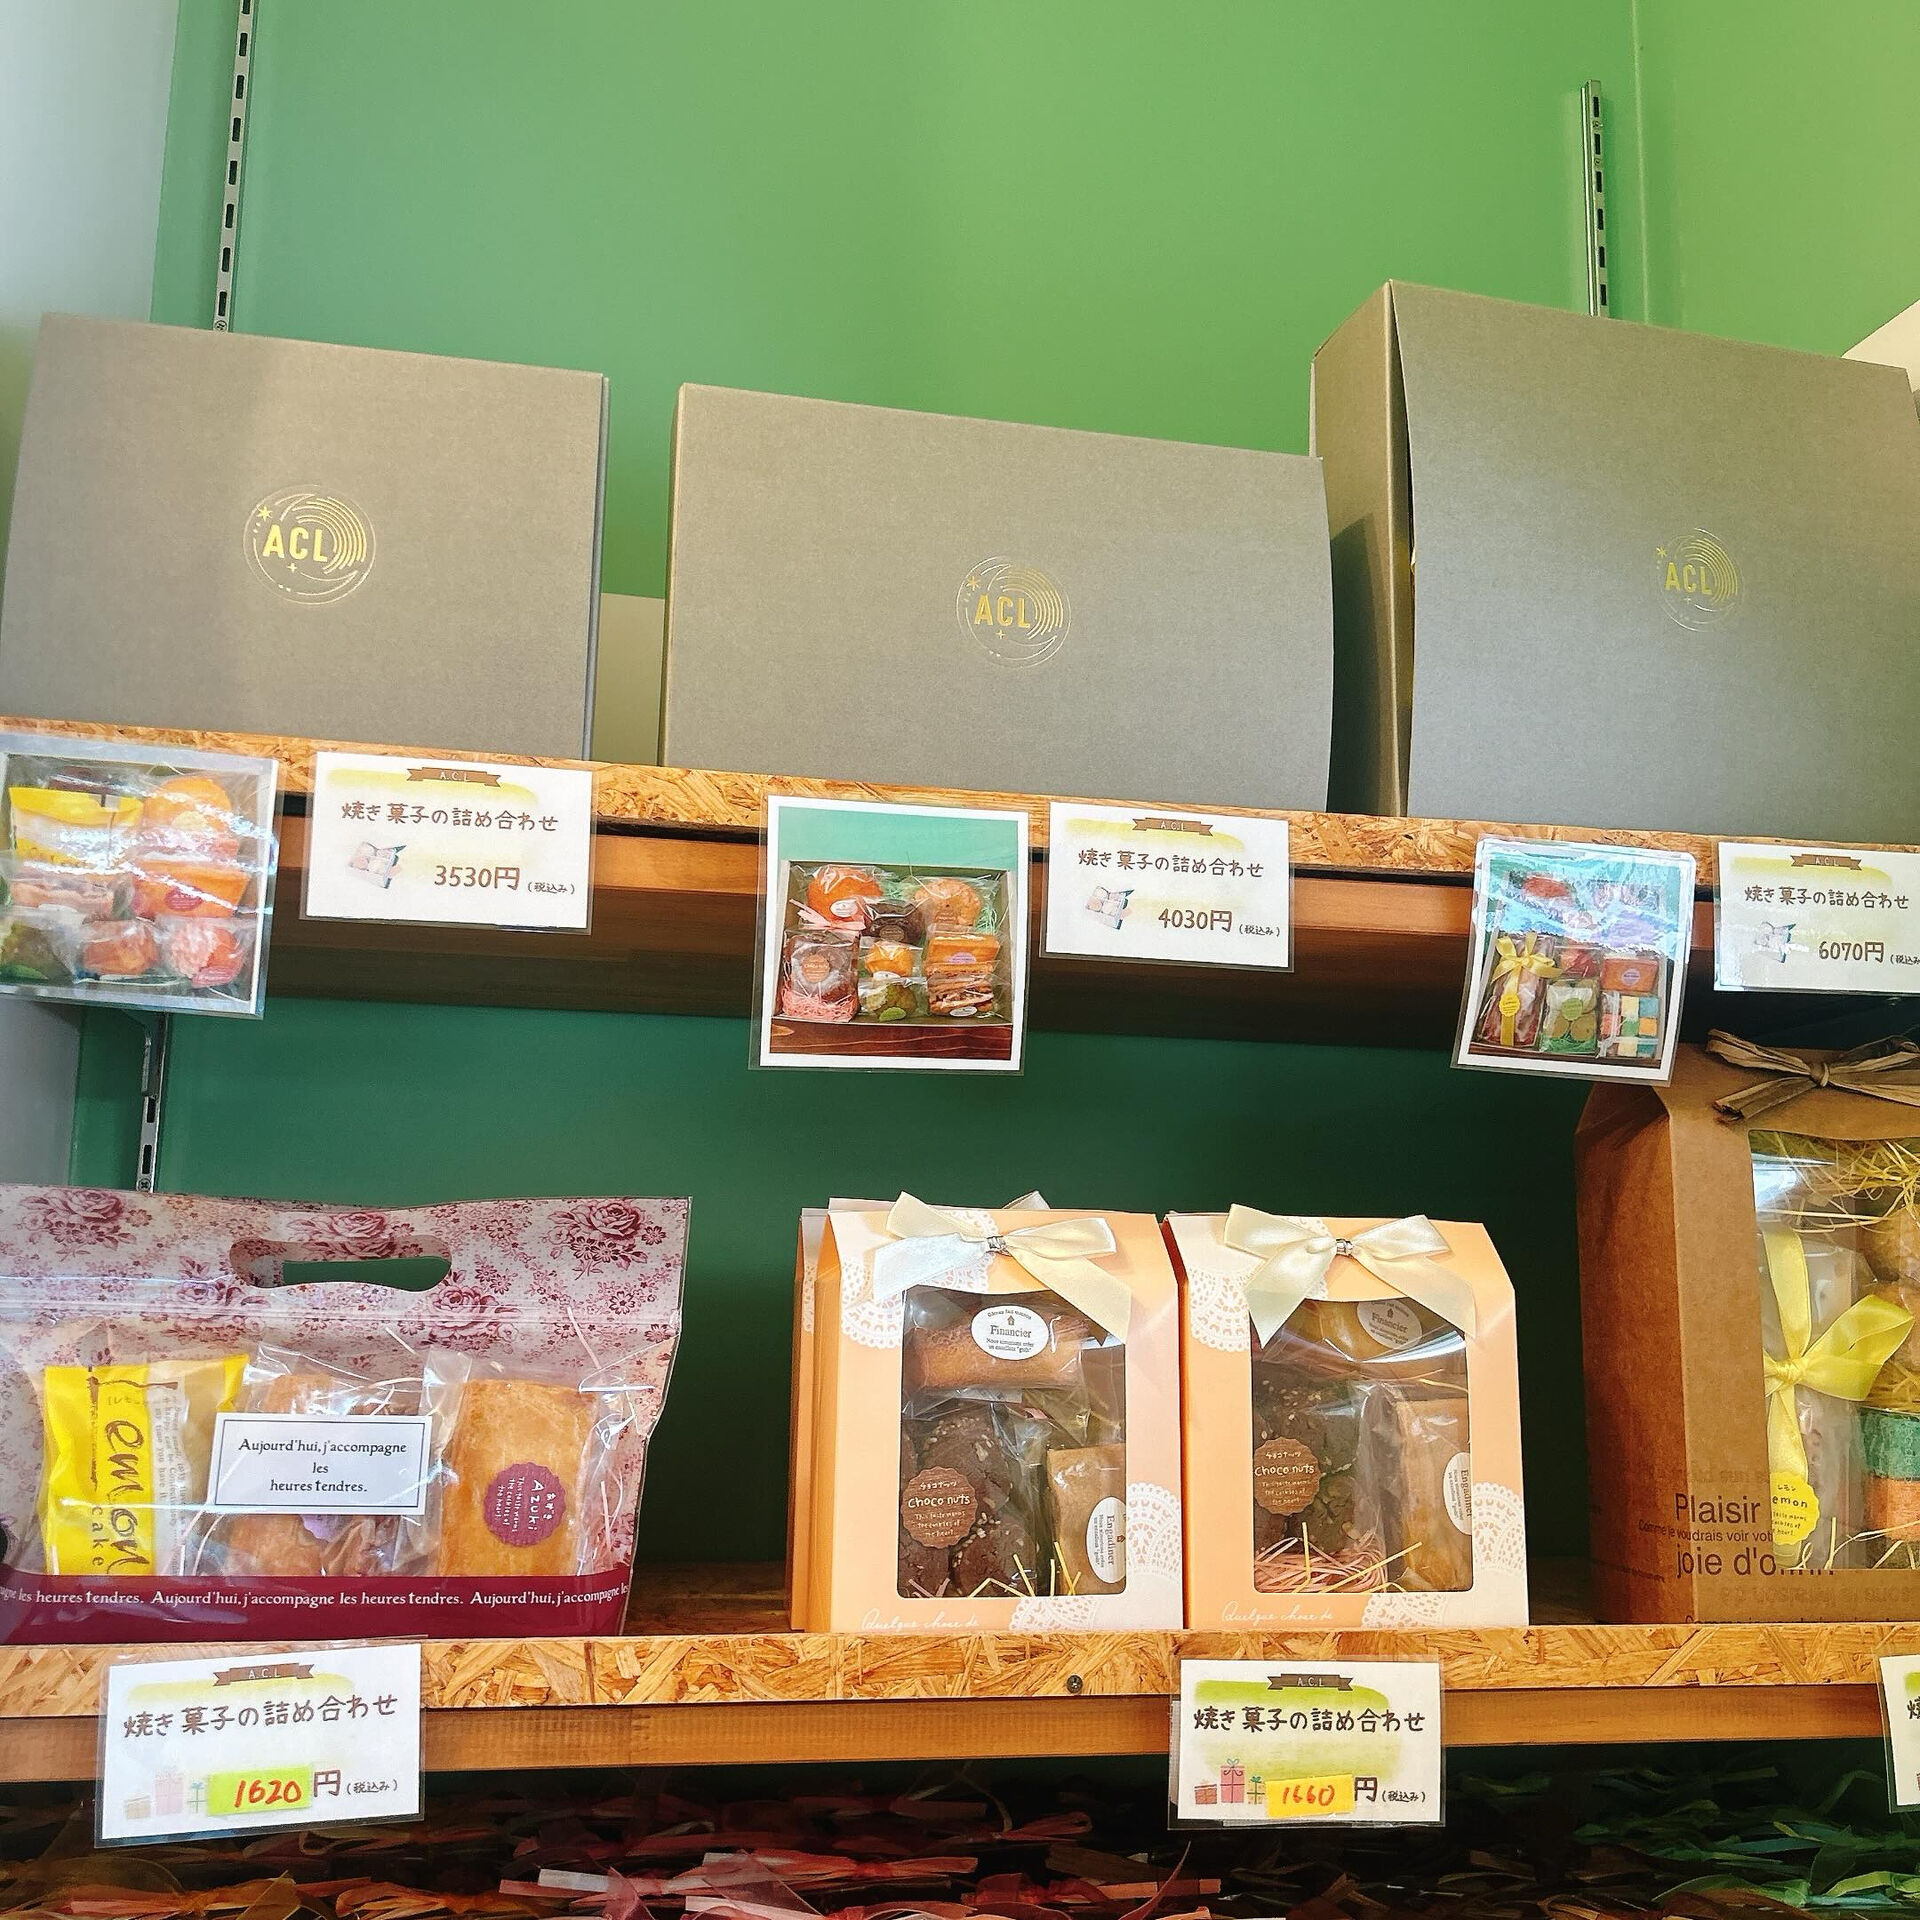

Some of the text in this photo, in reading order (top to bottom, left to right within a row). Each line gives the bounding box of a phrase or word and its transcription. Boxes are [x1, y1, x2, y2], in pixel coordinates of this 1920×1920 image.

[262, 524, 328, 563] ACL
[1663, 561, 1713, 596] ACL
[973, 593, 1031, 629] ACL
[341, 801, 559, 832] 焼き菓子の詰め合わせ
[1078, 847, 1265, 878] 焼き菓子の詰め合わせ
[433, 864, 521, 891] 3530円
[1744, 884, 1909, 910] 焼き菓子の詰め合わせ
[1158, 908, 1233, 933] 4030円
[1818, 940, 1885, 964] 6070円
[990, 1324, 1032, 1339] Financier
[312, 1462, 329, 1474] les
[1292, 1463, 1315, 1474] nuts
[270, 1479, 368, 1493] heures tendres.
[947, 1494, 971, 1505] nuts
[528, 1479, 545, 1531] Azuki
[1674, 1492, 1762, 1525] Plaisir
[1772, 1495, 1808, 1508] emon
[91, 1505, 110, 1566] cake
[1105, 1514, 1116, 1566] Engadiner
[1675, 1528, 1724, 1543] voudrais
[1726, 1529, 1750, 1542] voir
[1676, 1543, 1723, 1580] joie
[36, 1591, 83, 1604] heures
[86, 1591, 144, 1604] tendres.
[339, 1592, 357, 1604] les
[360, 1592, 406, 1605] heures
[408, 1591, 464, 1605] tendres.
[123, 1693, 399, 1739] 焼き菓子の詰め合わせ
[1193, 1705, 1426, 1733] 焼き菓子の詰め合わせ
[234, 1779, 302, 1808] 1620
[313, 1769, 341, 1798] 円
[1282, 1785, 1336, 1807] 1660
[1354, 1776, 1378, 1803] 円
